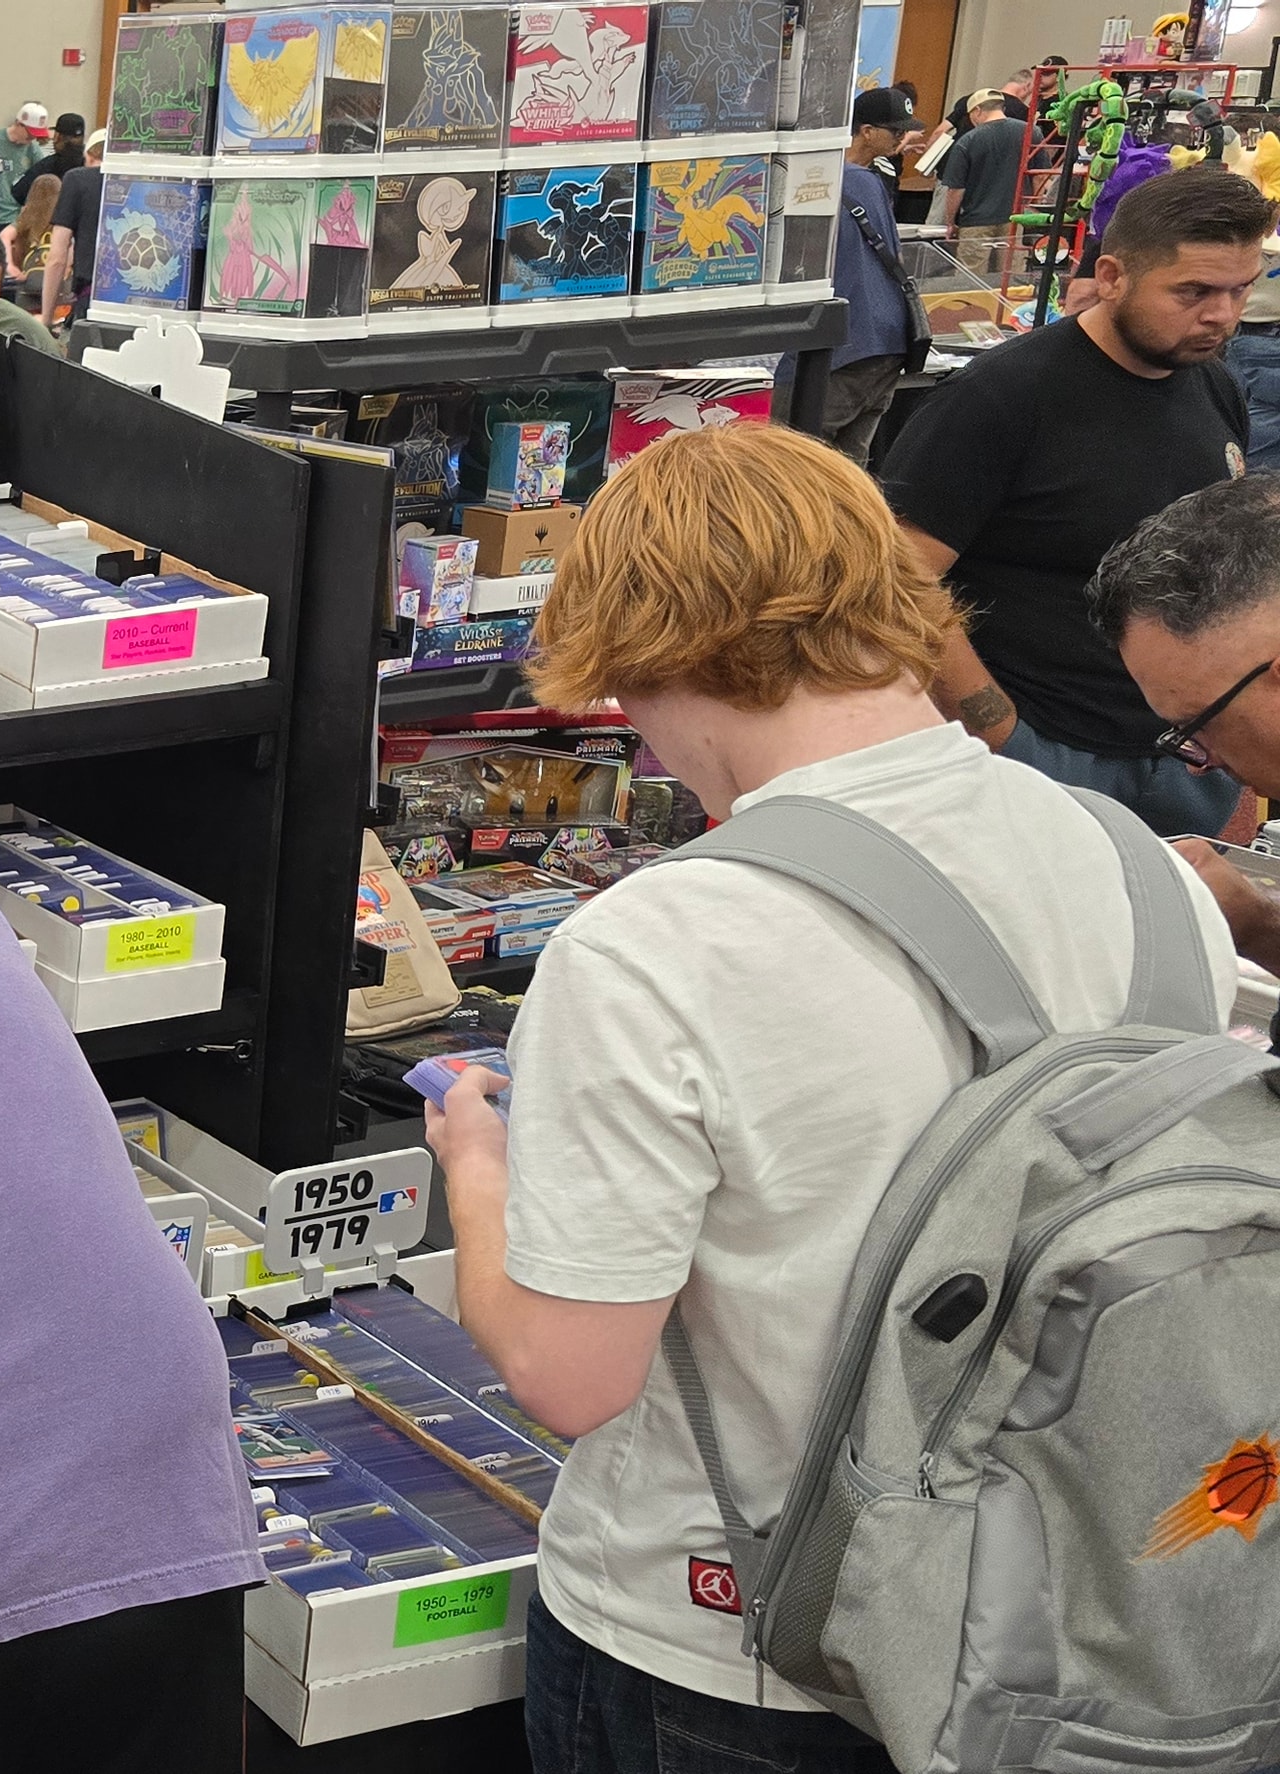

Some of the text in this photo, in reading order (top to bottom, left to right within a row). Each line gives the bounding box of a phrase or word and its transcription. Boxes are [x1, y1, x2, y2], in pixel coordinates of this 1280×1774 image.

[527, 107, 570, 119] WHITE
[394, 481, 442, 498] EVOLUTION
[519, 583, 539, 600] FINAL
[518, 608, 533, 616] PLAY
[112, 626, 139, 641] 2010
[150, 620, 190, 637] Current
[460, 626, 495, 641] WILDS
[128, 636, 170, 650] BASEBALL
[454, 636, 504, 652] ELDRAINE
[576, 743, 626, 755] PRISMATIC
[509, 836, 549, 846] PRISMATIC
[537, 904, 576, 915] FIRST PARTNER
[120, 931, 145, 944] 1980
[156, 926, 181, 939] 2010
[129, 942, 169, 954] BASEBALL
[294, 1170, 374, 1213] 1950
[290, 1215, 370, 1258] 1979
[416, 1595, 447, 1612] 1950
[463, 1586, 495, 1602] 1979
[426, 1605, 478, 1623] FOOTBALL
